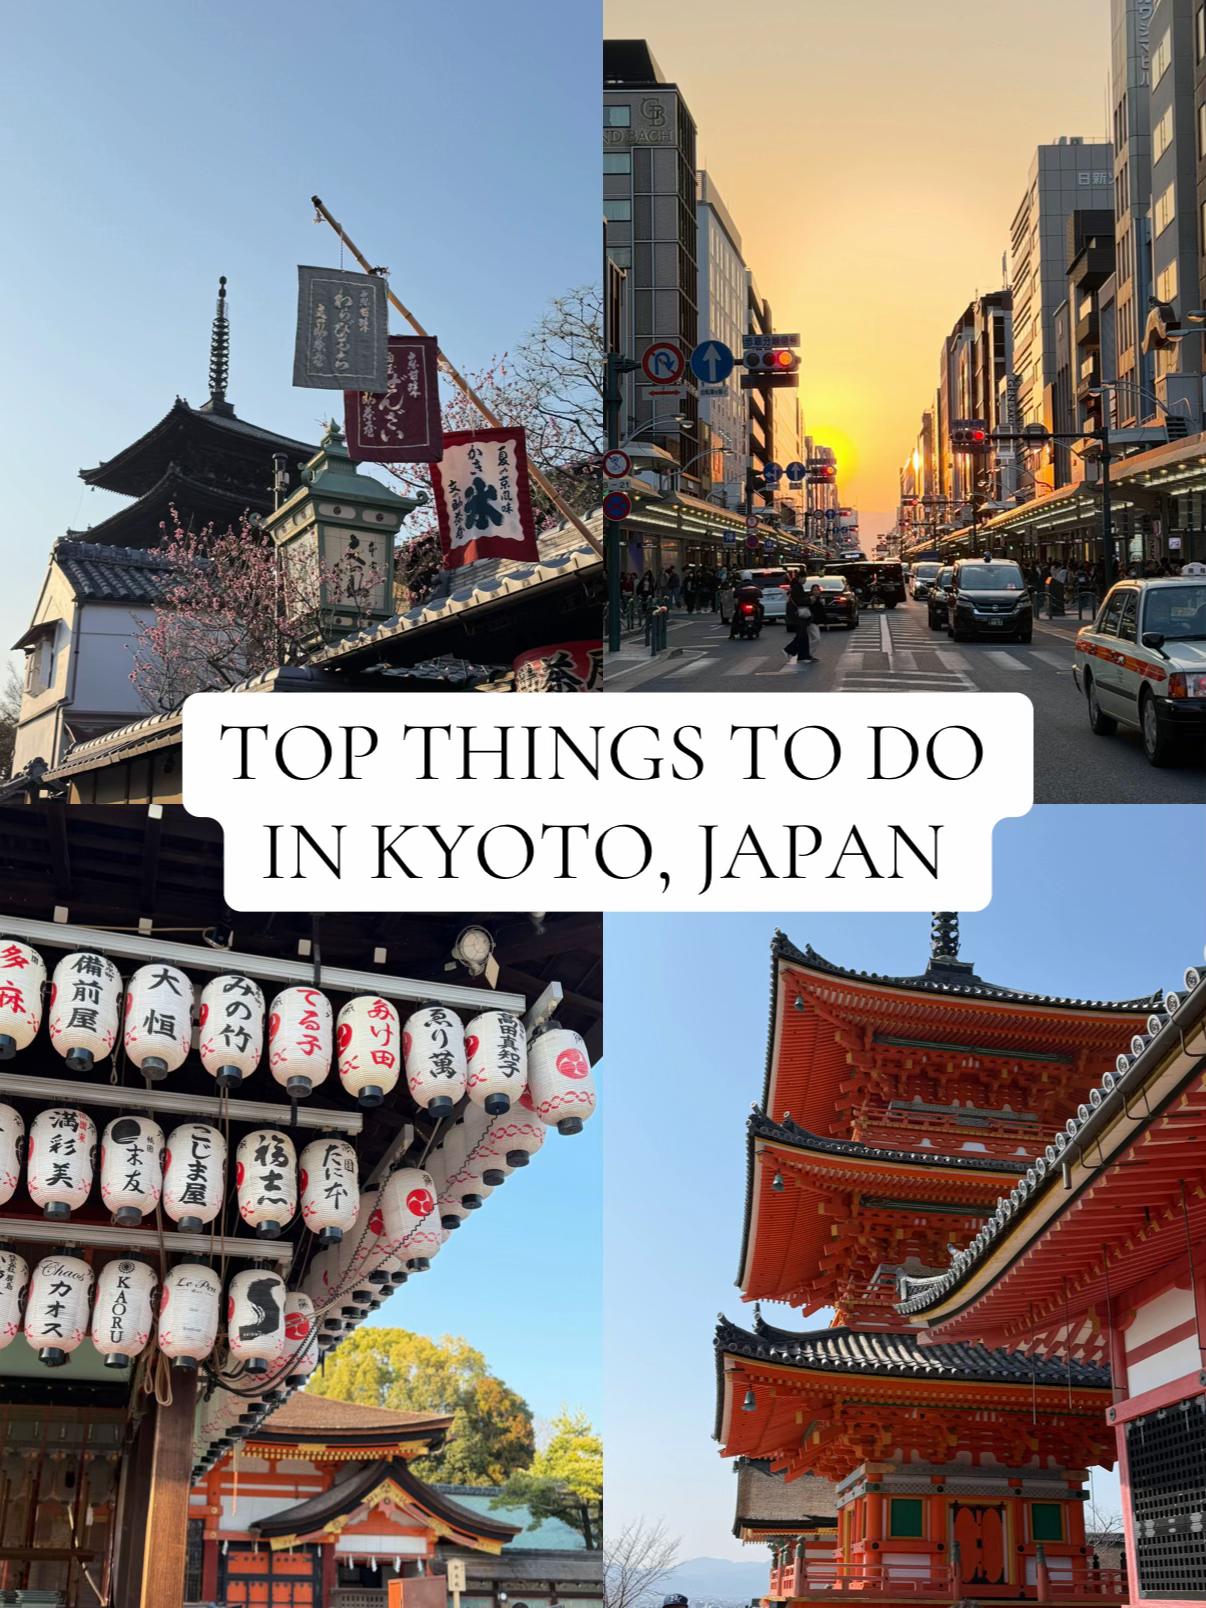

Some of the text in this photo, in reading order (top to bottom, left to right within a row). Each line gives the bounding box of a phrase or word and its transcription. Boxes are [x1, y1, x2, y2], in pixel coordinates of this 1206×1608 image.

[66, 954, 104, 1033] 備前屋
[142, 967, 182, 1041] 大恒
[219, 975, 255, 1053] みの竹
[296, 989, 322, 1056] てる子
[45, 1111, 80, 1188] 満彩美
[178, 1126, 212, 1206] こじま屋
[41, 1281, 72, 1338] カオス
[110, 1275, 131, 1344] KAORU
